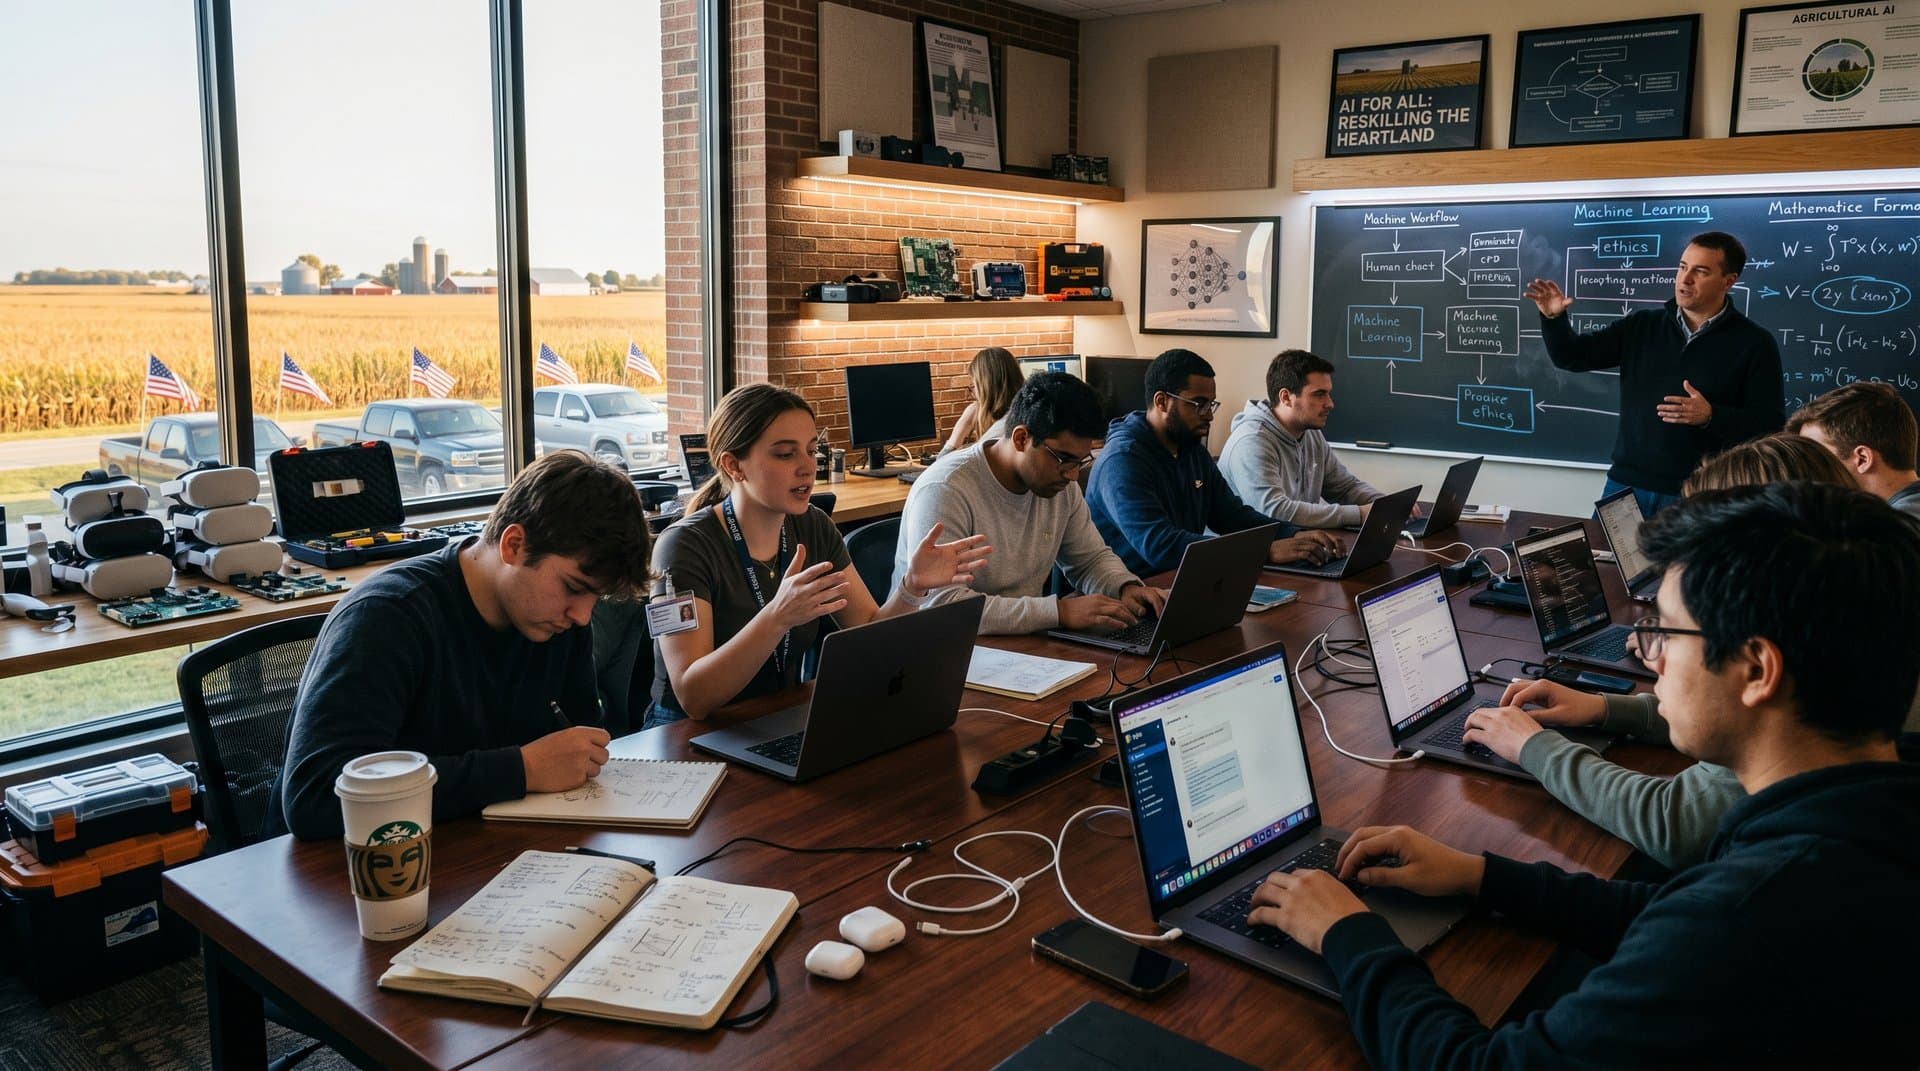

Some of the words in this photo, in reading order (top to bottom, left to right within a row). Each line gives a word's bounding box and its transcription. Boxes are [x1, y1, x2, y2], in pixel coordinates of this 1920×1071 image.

[1792, 8, 1879, 24] AGRICULTURAL
[1883, 5, 1895, 15] AI
[1340, 98, 1355, 114] AI
[1361, 96, 1392, 112] FOR
[1396, 94, 1432, 109] ALL:
[1338, 110, 1432, 131] RESKILLING
[1437, 107, 1470, 124] THE
[1337, 128, 1434, 147] HEARTLAND
[1364, 212, 1406, 225] Machine
[1410, 210, 1459, 223] Workflow
[1574, 203, 1633, 219] Machine
[1642, 202, 1710, 223] Learning
[1603, 240, 1649, 253] ethics
[1366, 260, 1401, 271] Human
[1353, 312, 1400, 327] Machine
[1453, 310, 1498, 321] Machine
[1360, 330, 1413, 353] Learning
[1459, 334, 1503, 354] learning
